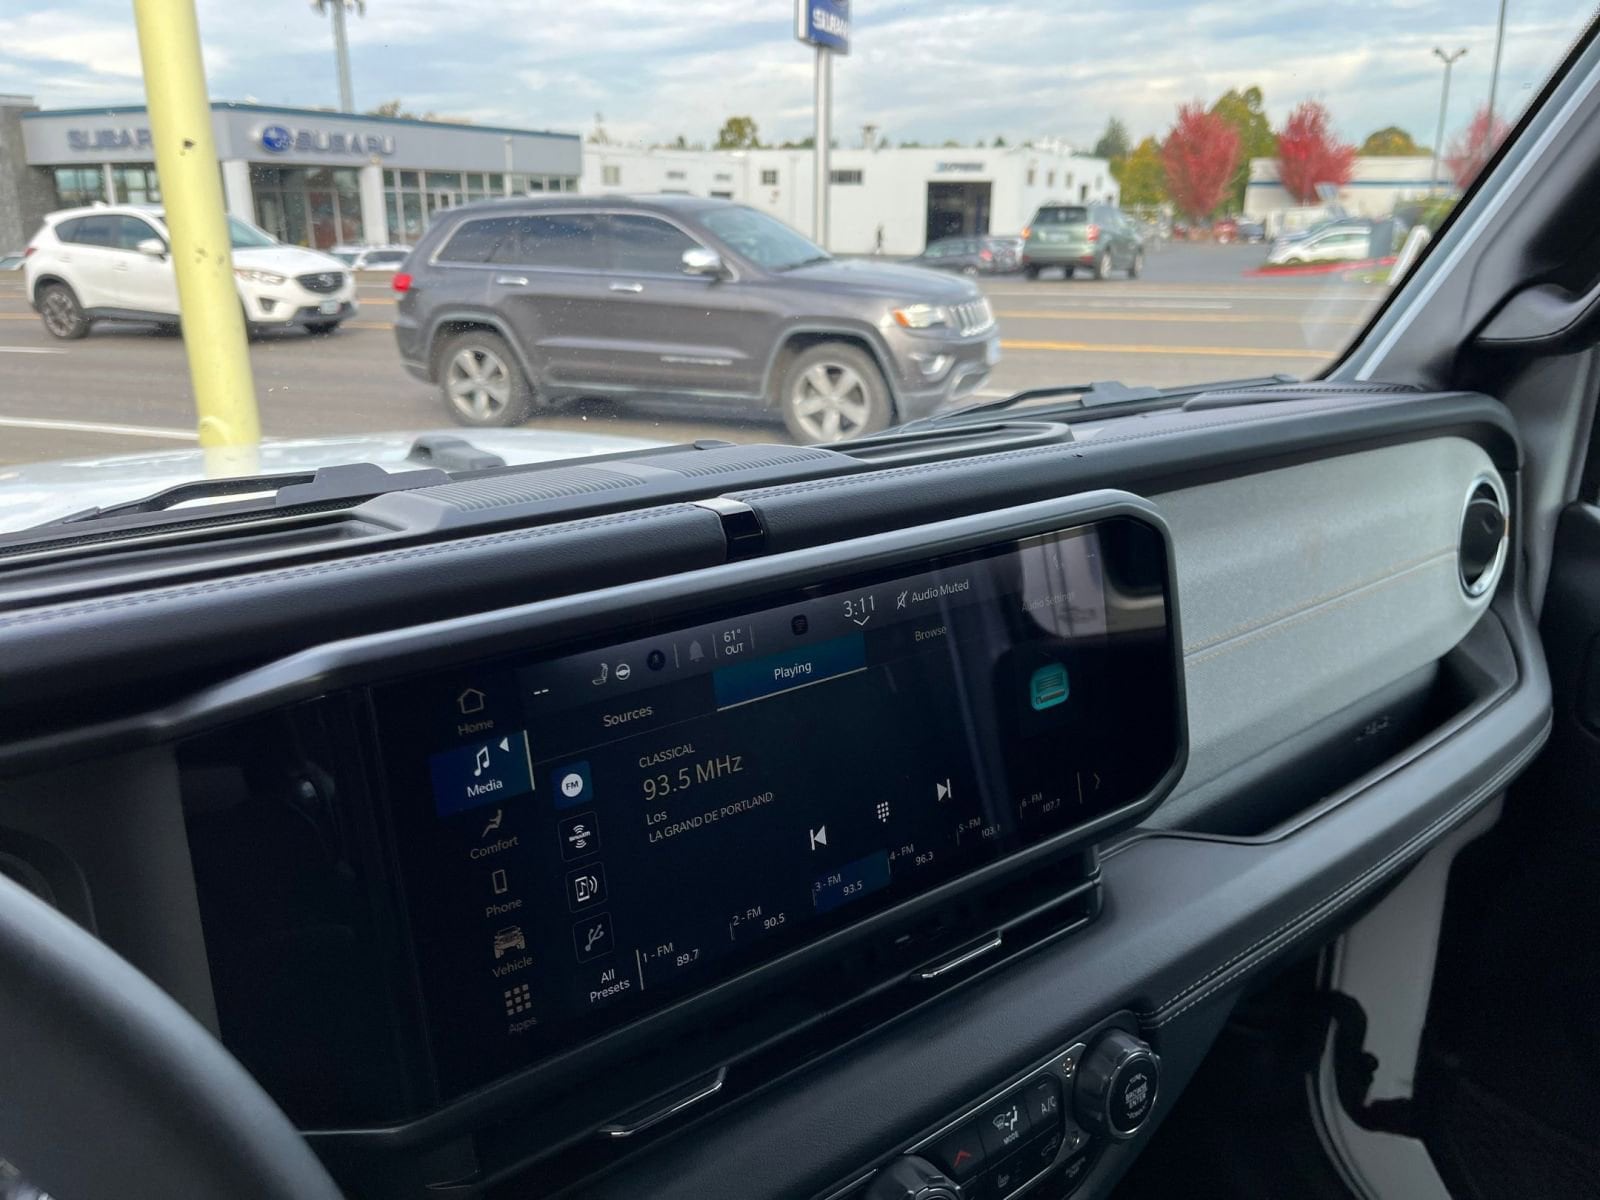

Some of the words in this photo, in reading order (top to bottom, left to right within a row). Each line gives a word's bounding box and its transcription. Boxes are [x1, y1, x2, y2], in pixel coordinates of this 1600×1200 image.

[67, 128, 153, 152] SUBAR
[295, 129, 396, 155] SUBARU
[911, 588, 939, 604] Audio
[940, 579, 969, 597] Muted
[843, 595, 875, 618] 3:11
[915, 625, 947, 642] Browse
[725, 642, 744, 655] OUT
[774, 662, 812, 680] Playing
[603, 705, 654, 728] Sources
[457, 718, 495, 736] Home
[638, 743, 696, 769] CLASSICAL
[565, 779, 580, 791] FM
[643, 768, 691, 802] 93.5
[696, 755, 744, 784] MHz
[467, 778, 504, 798] Media
[646, 809, 668, 826] Los
[649, 830, 664, 843] LA
[664, 815, 703, 839] GRAND
[703, 809, 720, 823] DE
[719, 791, 774, 819] PORTLAND
[470, 834, 519, 860] Comfort
[901, 844, 914, 857] FM
[915, 851, 934, 866] 96.3
[827, 873, 842, 887] FM
[843, 880, 863, 896] 93.5
[485, 897, 523, 918] Phone
[747, 906, 763, 920] FM
[763, 913, 786, 930] 90.5
[656, 943, 674, 958] FM
[676, 949, 699, 967] 89.7
[492, 955, 533, 978] Vehicle
[600, 968, 615, 984] All
[589, 979, 630, 1002] Presets
[508, 1016, 537, 1034] Apps
[1041, 1096, 1057, 1115] A/C
